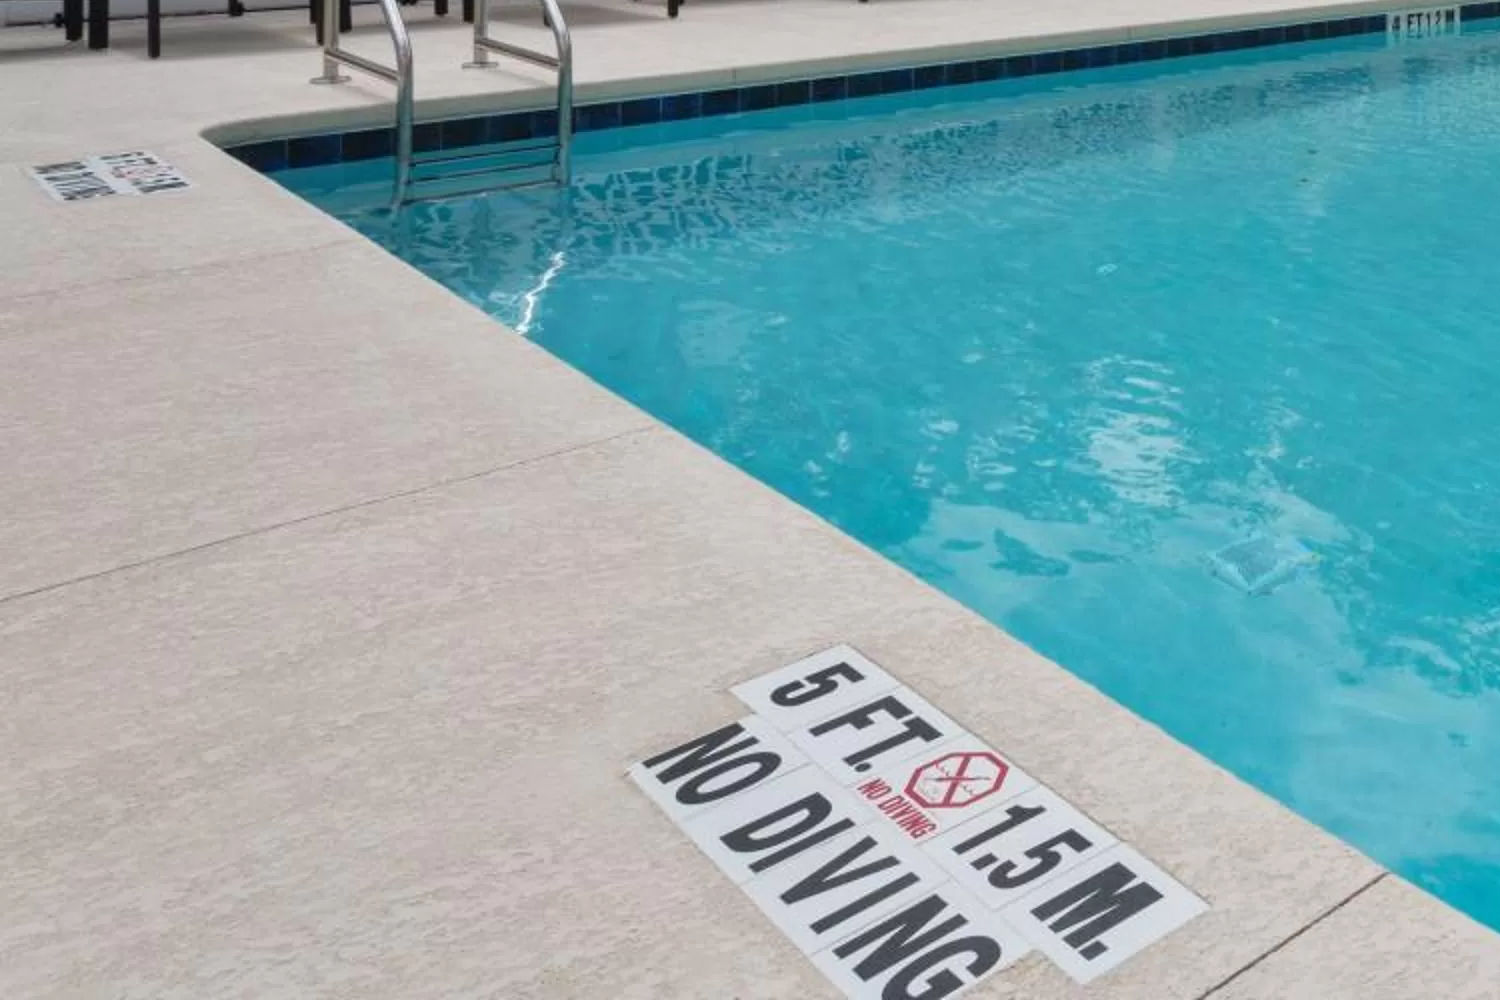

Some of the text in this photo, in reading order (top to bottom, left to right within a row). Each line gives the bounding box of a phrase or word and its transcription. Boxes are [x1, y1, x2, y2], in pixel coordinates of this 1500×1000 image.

[769, 662, 944, 773] 5 FT.
[642, 722, 1002, 1000] NO DIVING
[857, 777, 938, 840] NO DIVING
[951, 804, 1165, 962] 1.5 M.
